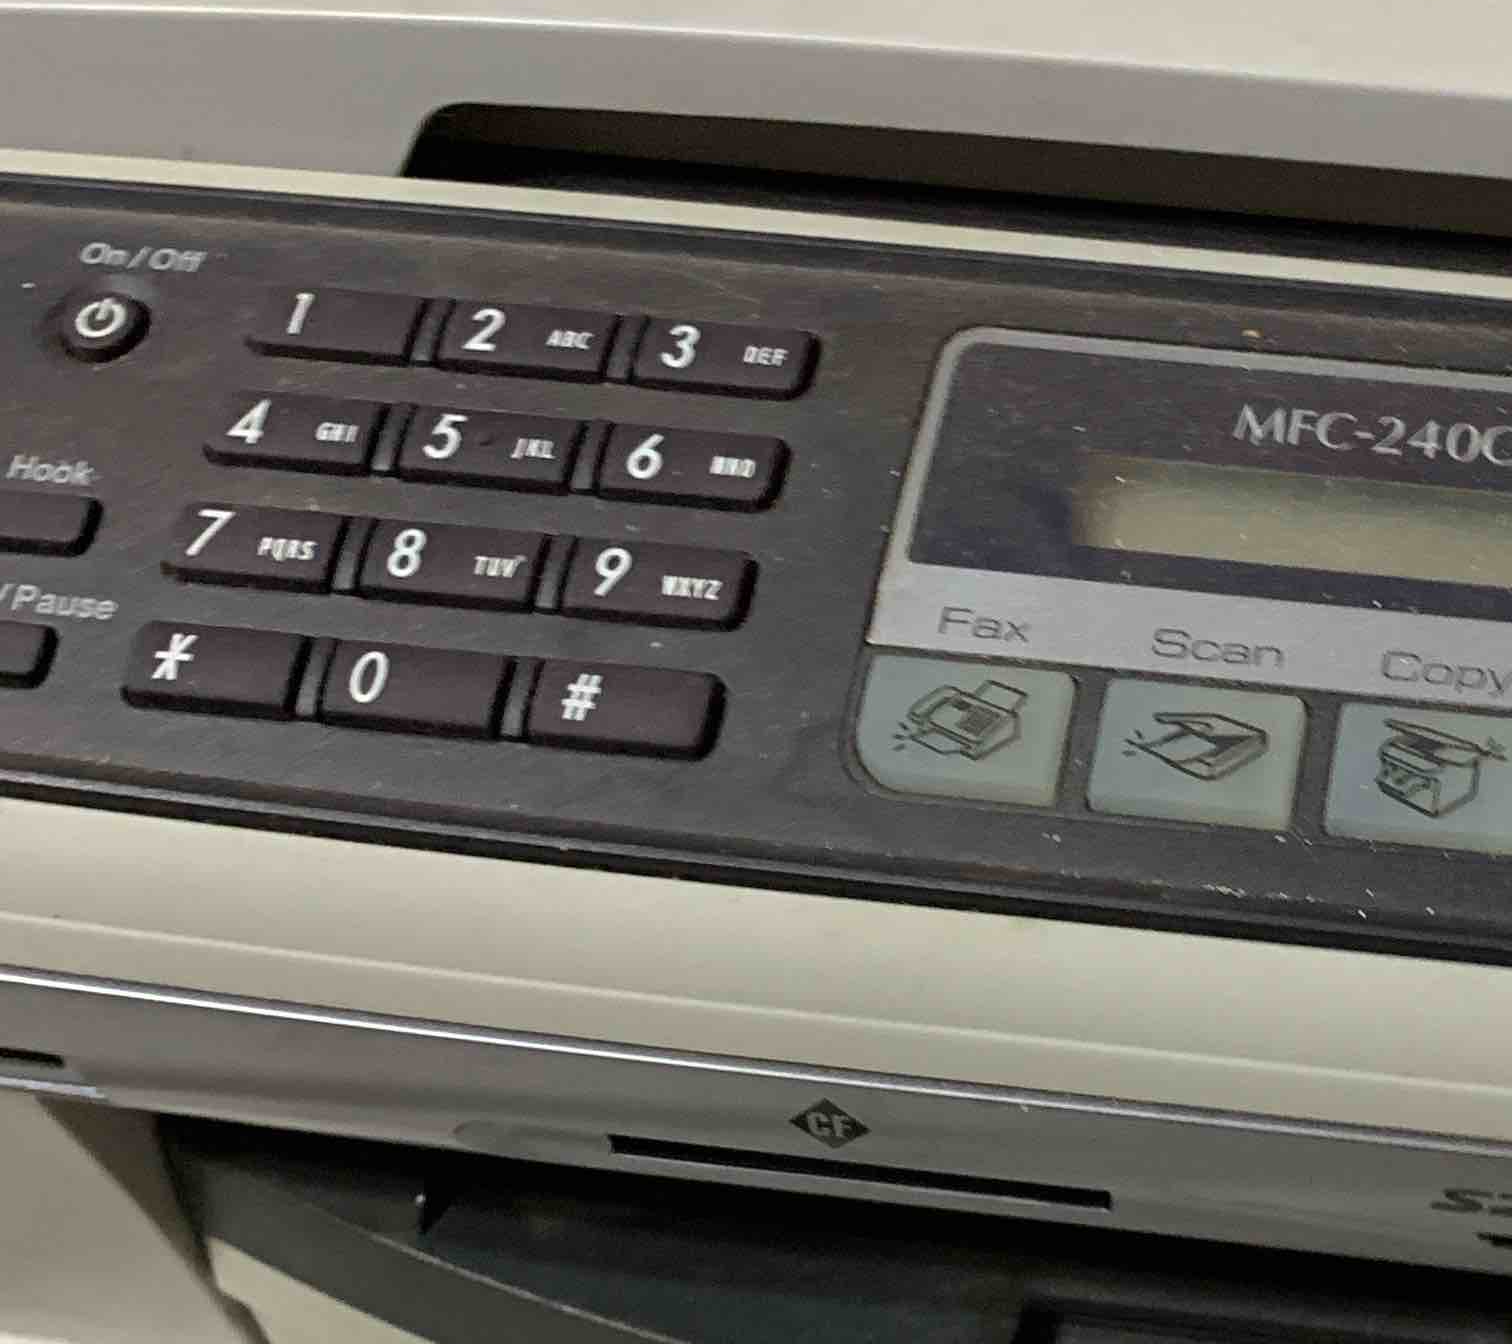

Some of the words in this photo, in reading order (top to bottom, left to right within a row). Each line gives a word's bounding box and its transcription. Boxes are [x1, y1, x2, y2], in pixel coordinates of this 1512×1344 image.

[286, 293, 316, 336] 1
[463, 308, 506, 352] 2
[545, 329, 595, 352] ABC
[660, 325, 701, 369] 3
[743, 345, 789, 368] DEF
[226, 399, 272, 444] 4
[315, 421, 360, 444] GHI
[423, 414, 468, 459] 5
[510, 438, 556, 460] JKL
[5, 455, 97, 485] Hook
[626, 434, 664, 480] 6
[185, 509, 236, 557] 7
[257, 536, 318, 561] PQRS
[386, 528, 427, 578] 8
[473, 555, 528, 579] TUV
[594, 547, 632, 596] 9
[662, 574, 723, 600] WXYZ
[937, 605, 1032, 644] Fax
[1149, 627, 1285, 668] Scan
[348, 651, 389, 704] 0
[560, 673, 602, 721] #
